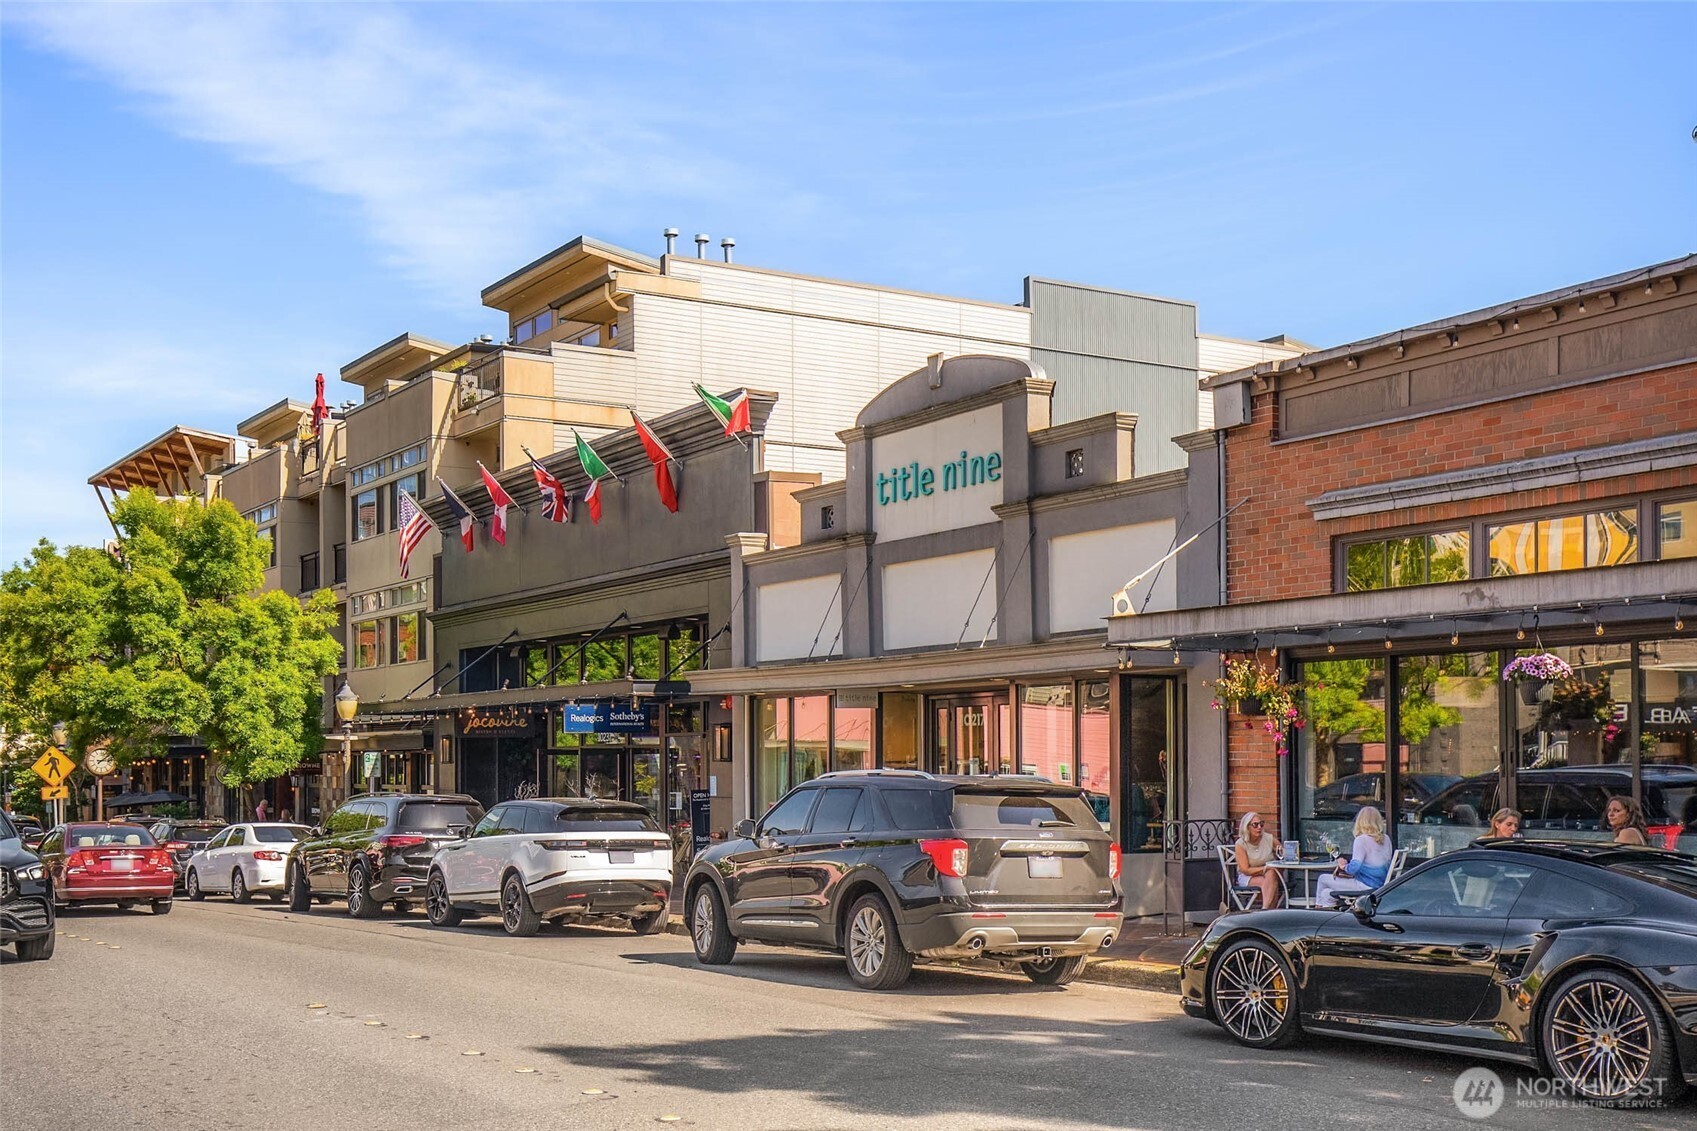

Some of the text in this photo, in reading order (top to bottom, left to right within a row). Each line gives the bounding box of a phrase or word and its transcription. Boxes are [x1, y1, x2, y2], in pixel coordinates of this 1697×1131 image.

[876, 450, 1002, 506] title nine
[570, 713, 604, 724] Realogics
[609, 711, 645, 722] Sotheby's
